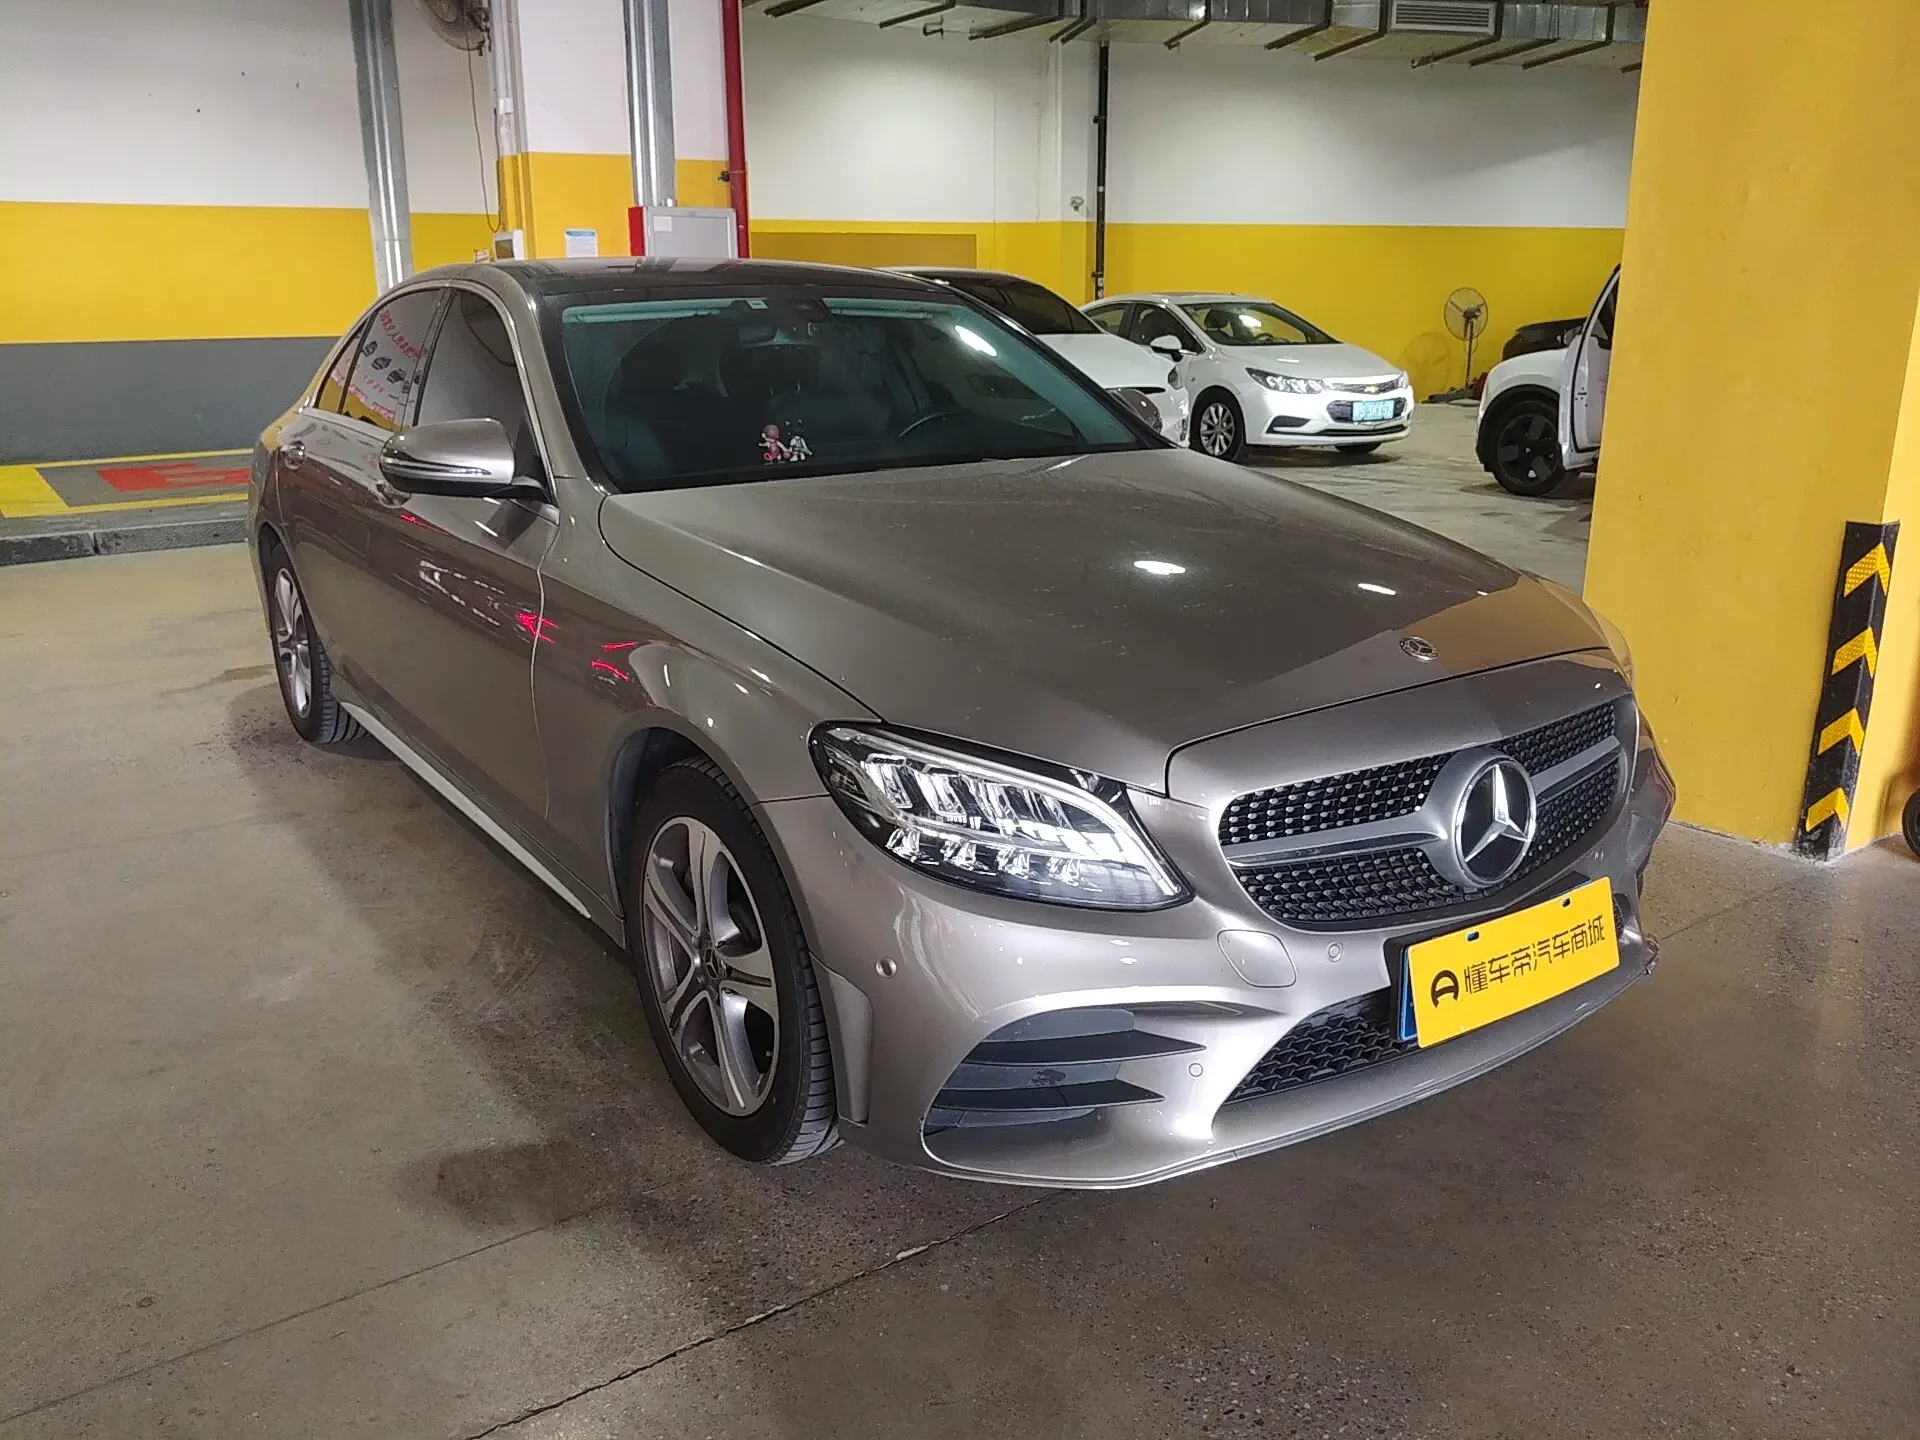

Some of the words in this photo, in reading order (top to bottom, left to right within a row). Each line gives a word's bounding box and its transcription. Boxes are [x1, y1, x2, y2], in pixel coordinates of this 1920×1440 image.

[1463, 914, 1606, 995] 懂车帝汽车商城
